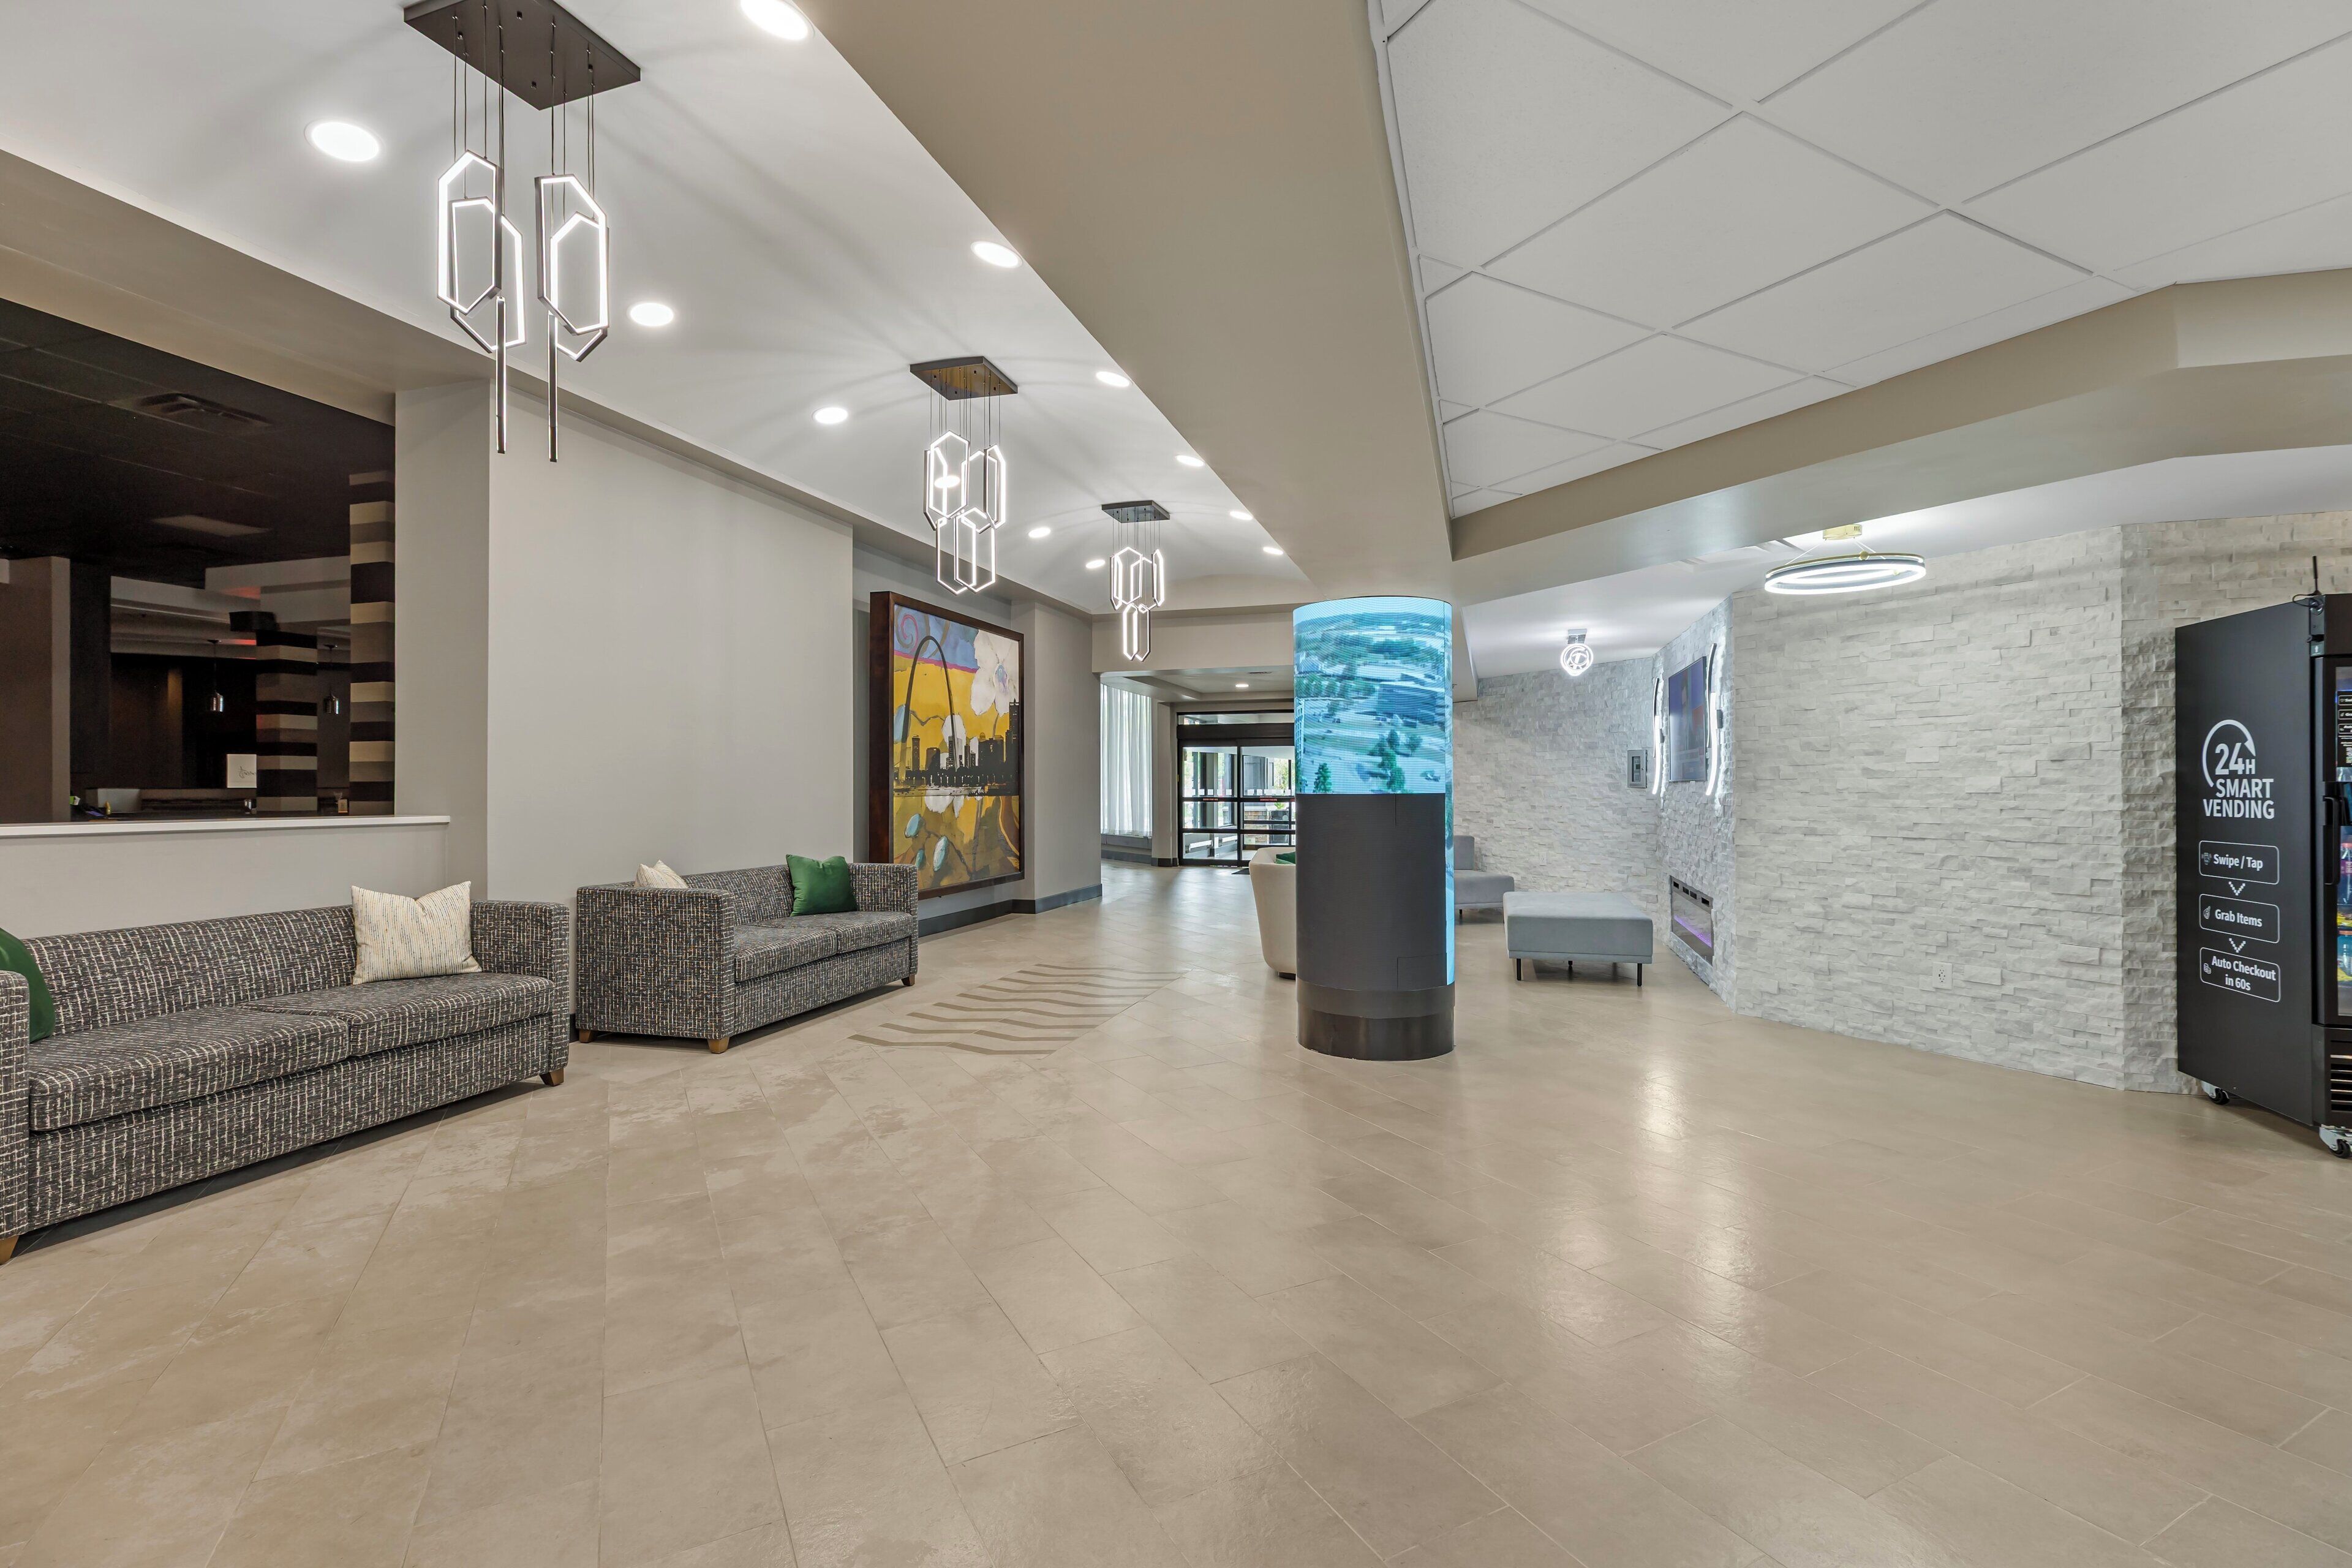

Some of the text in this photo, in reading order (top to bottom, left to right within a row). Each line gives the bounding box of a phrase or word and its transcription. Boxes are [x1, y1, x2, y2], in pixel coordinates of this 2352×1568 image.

[2215, 742, 2255, 775] 24H
[2215, 778, 2274, 798] SMART
[2203, 799, 2274, 820] VENDING
[2214, 853, 2240, 869] Swipe
[2245, 856, 2263, 871] Tap
[2215, 909, 2263, 927] Grab Items
[2212, 956, 2276, 981] Auto Checkout
[2225, 974, 2252, 991] in 60s
